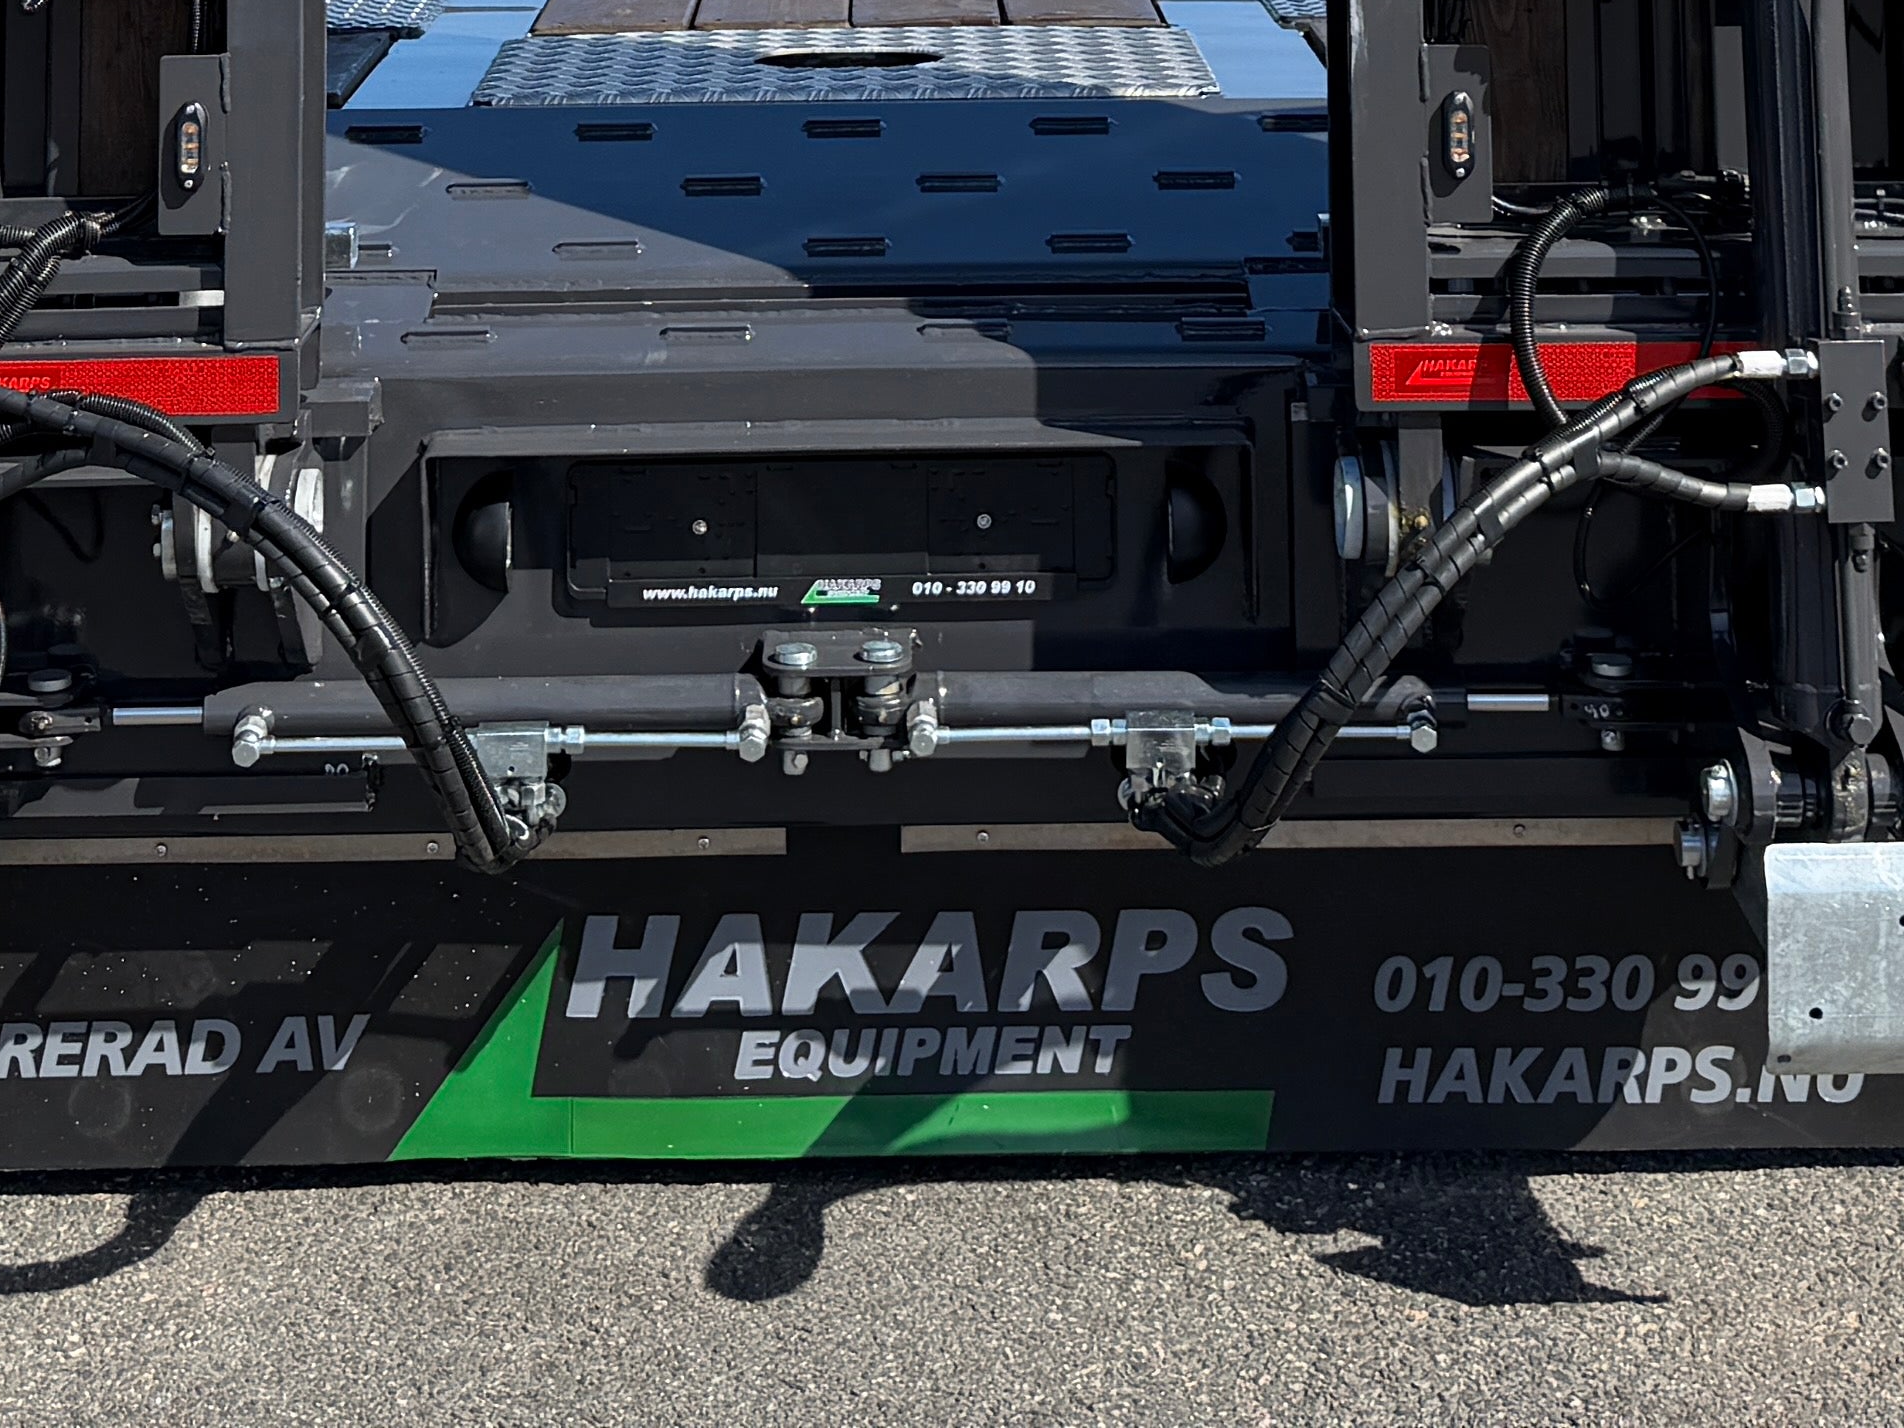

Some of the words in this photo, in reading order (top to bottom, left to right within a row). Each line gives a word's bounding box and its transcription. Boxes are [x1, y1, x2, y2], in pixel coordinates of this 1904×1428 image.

[642, 585, 779, 602] www.hakarps.nu
[912, 581, 944, 595] 010
[956, 580, 988, 595] 330
[991, 580, 1012, 595] 99
[1016, 579, 1036, 594] 10
[565, 905, 1296, 1020] HAKARPS
[1373, 952, 1657, 1014] 010-330
[1673, 952, 1761, 1012] 99
[255, 1012, 373, 1075] AV
[733, 1023, 1132, 1083] EQUIPMENT
